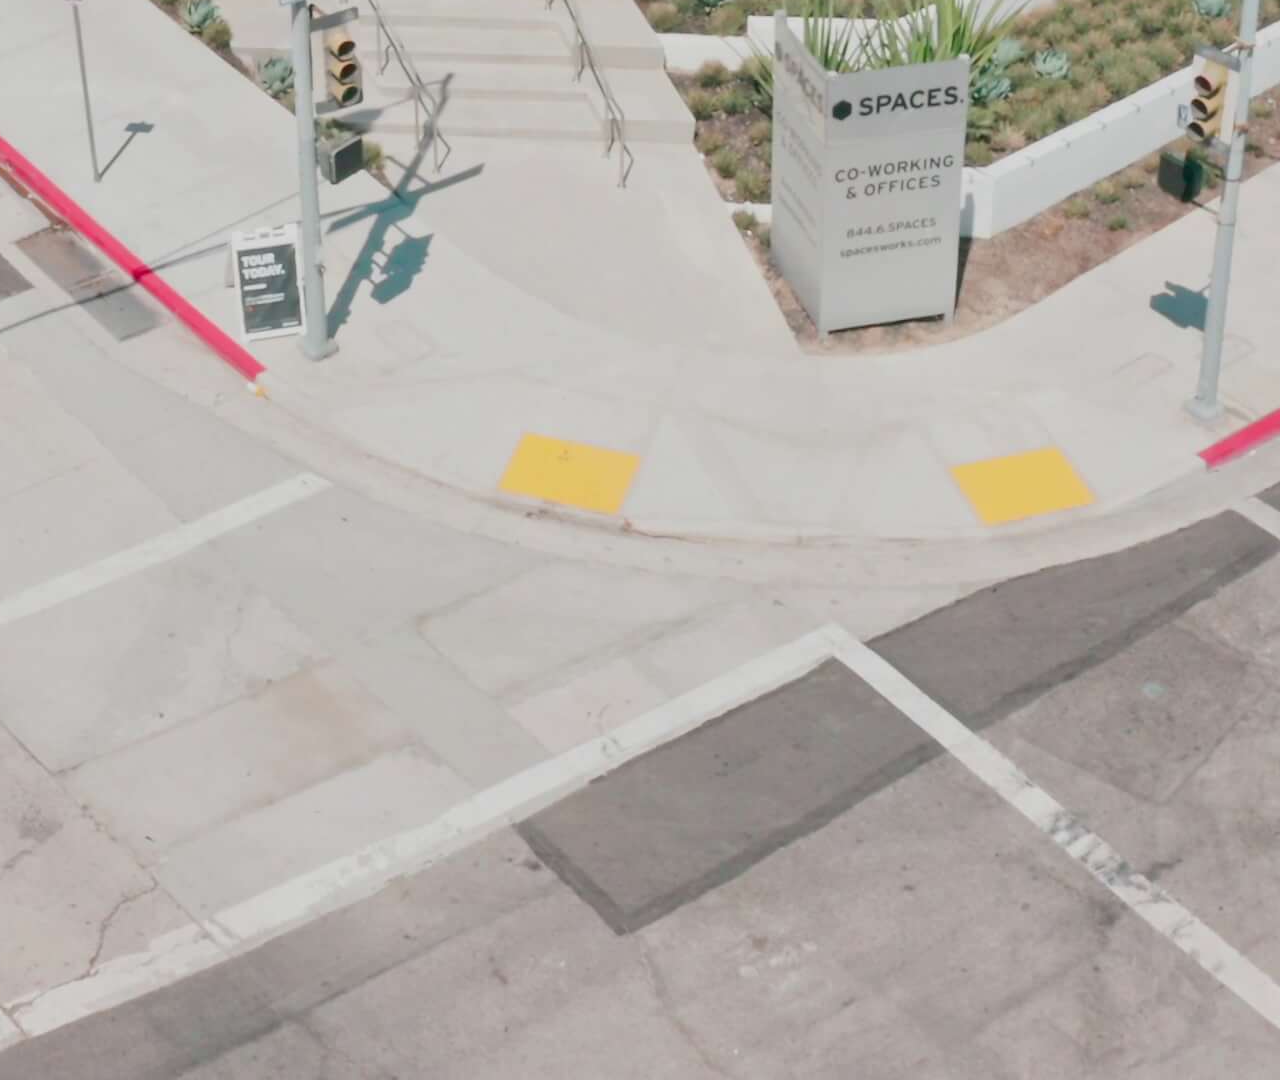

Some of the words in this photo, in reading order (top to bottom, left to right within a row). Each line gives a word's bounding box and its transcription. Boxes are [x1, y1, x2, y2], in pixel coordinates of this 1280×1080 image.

[859, 86, 964, 116] SPACES.
[835, 154, 954, 183] CO-WORKING
[846, 186, 857, 199] &
[864, 174, 941, 196] OFFICES
